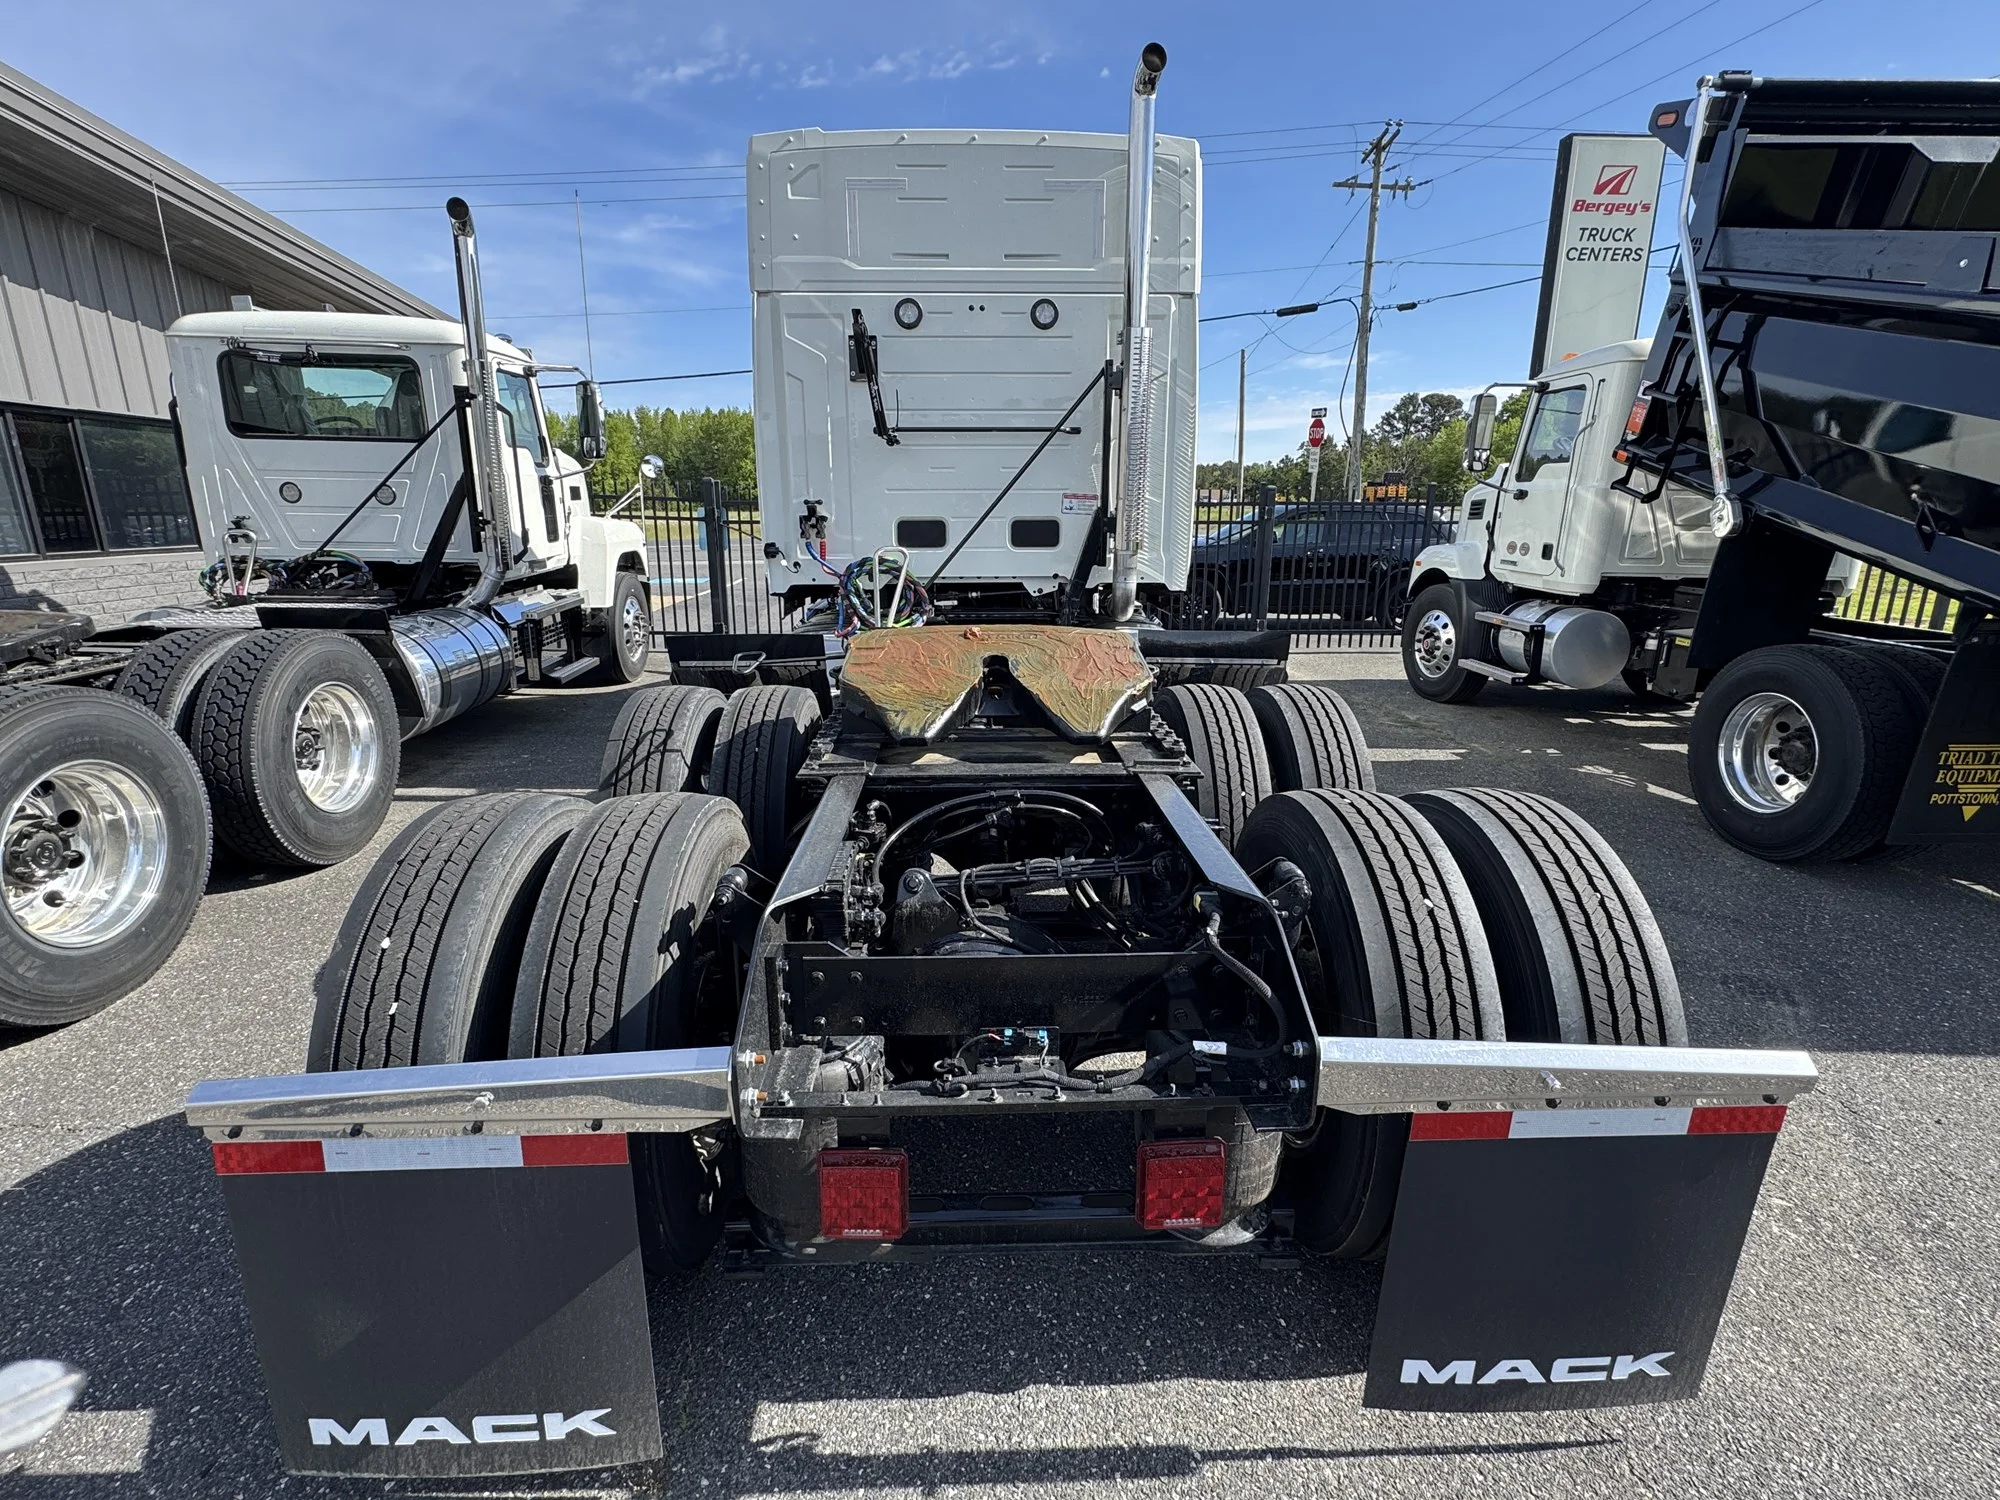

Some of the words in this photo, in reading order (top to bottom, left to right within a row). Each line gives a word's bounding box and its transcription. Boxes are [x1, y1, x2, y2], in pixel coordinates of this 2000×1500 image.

[1572, 199, 1652, 216] Bergey's
[1578, 227, 1638, 242] TRUCK
[1565, 247, 1644, 263] CENTERS
[1309, 427, 1324, 439] STOP
[1937, 751, 1986, 765] TRIAD
[1935, 769, 2000, 786] EQUIPM
[1400, 1351, 1676, 1385] MACK
[308, 1407, 618, 1446] MACK
